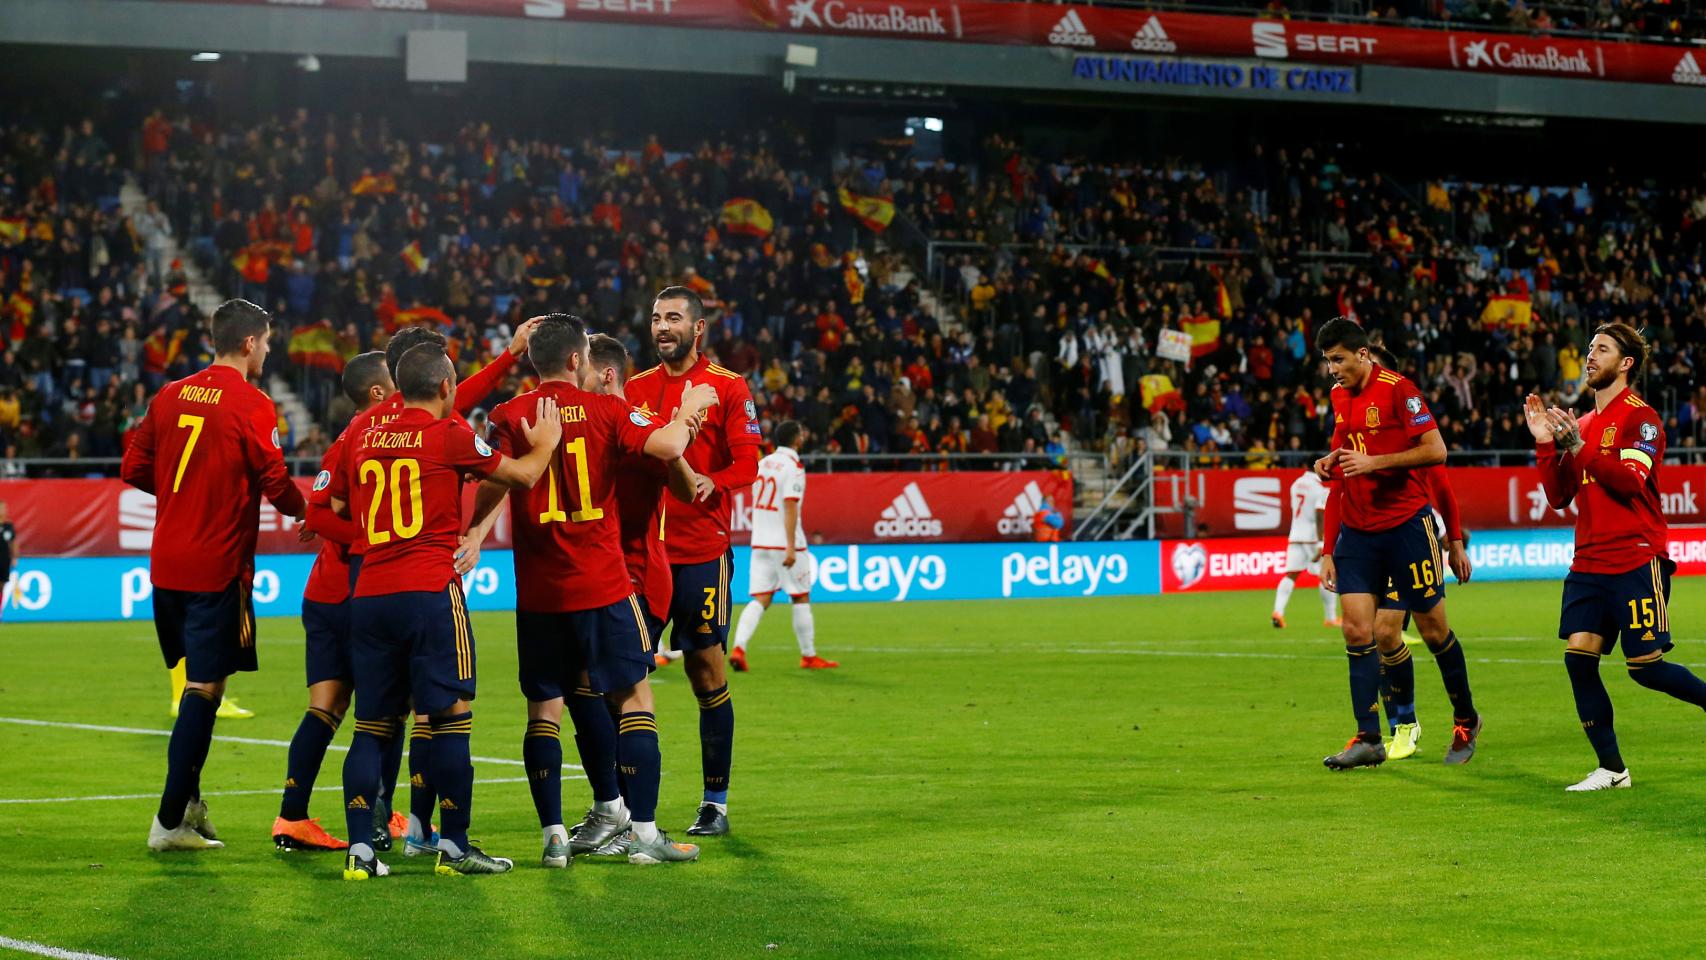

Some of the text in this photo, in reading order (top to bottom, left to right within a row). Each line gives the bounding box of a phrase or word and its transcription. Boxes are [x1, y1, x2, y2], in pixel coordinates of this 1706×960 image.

[823, 0, 946, 34] CaixaBank
[1048, 32, 1095, 46] adidas
[1131, 37, 1177, 52] adidas
[1295, 33, 1377, 55] SEAT
[1074, 56, 1244, 88] AYUNTAMIENTO
[1252, 65, 1280, 89] DE
[1493, 42, 1592, 73] CaixaBank
[178, 384, 223, 405] MORATA
[173, 413, 205, 493] 7
[371, 430, 423, 449] CAZORLA
[539, 437, 604, 524] 11
[755, 475, 778, 512] 22
[359, 458, 424, 545] 20
[1295, 493, 1305, 518] 7
[874, 518, 943, 537] adidas
[1002, 544, 1128, 597] pelayo
[1470, 543, 1523, 568] UEFA
[1409, 559, 1434, 589] 16
[702, 587, 716, 620] 3
[1628, 598, 1655, 629] 15
